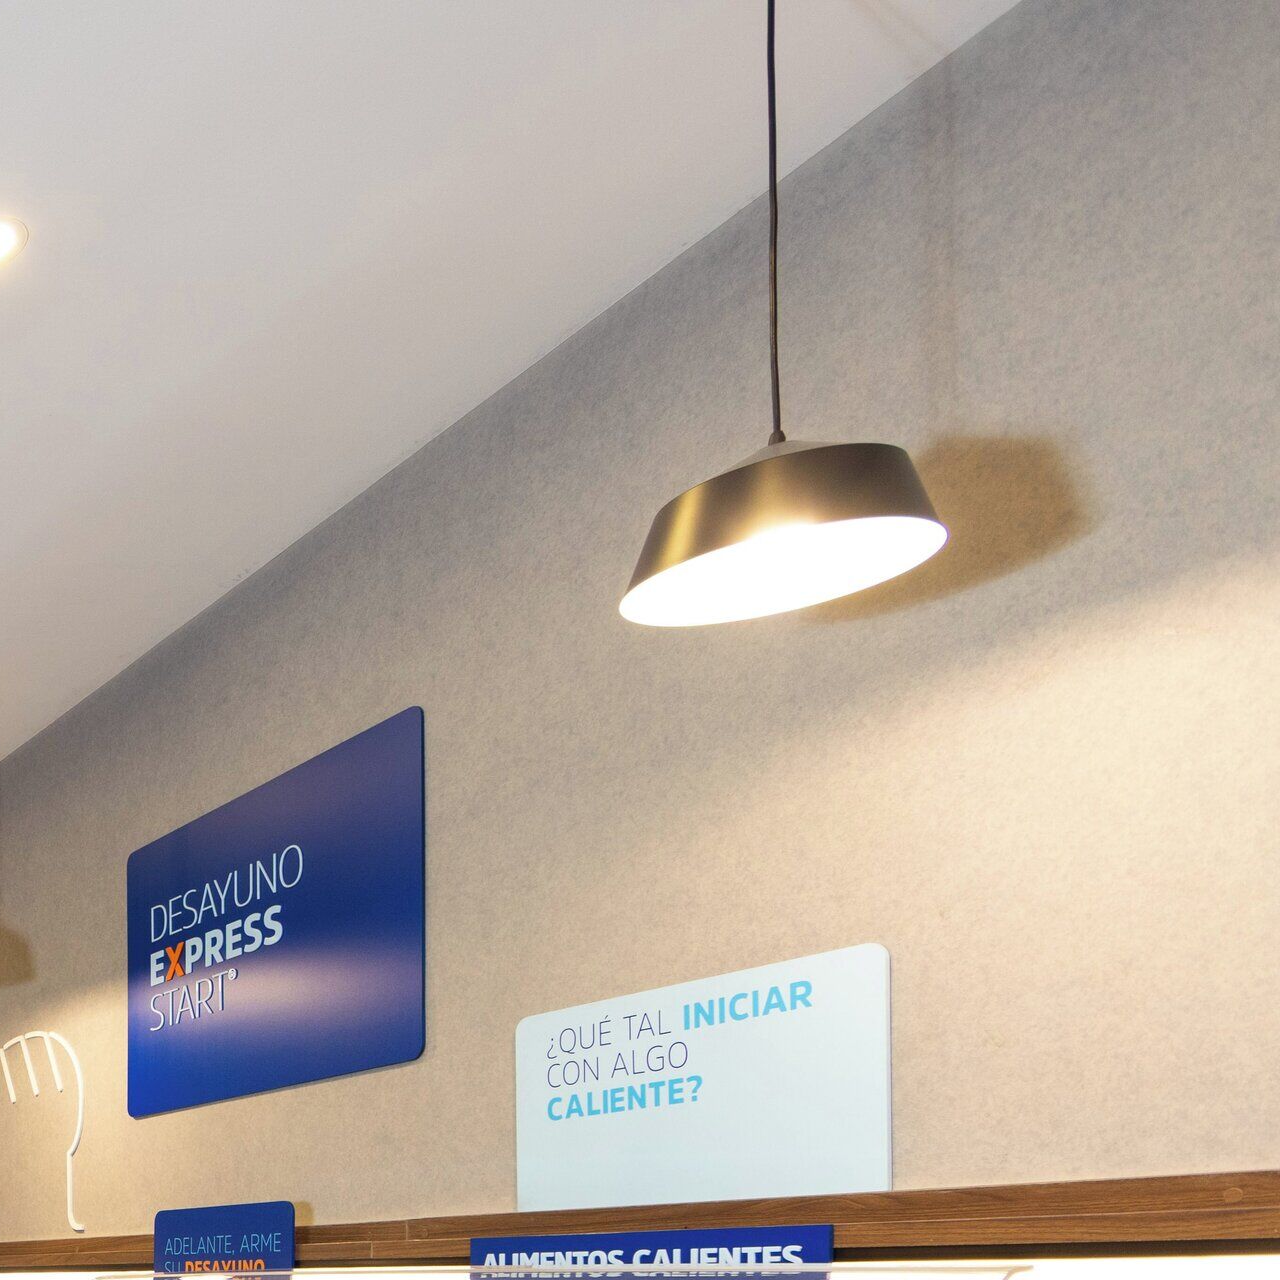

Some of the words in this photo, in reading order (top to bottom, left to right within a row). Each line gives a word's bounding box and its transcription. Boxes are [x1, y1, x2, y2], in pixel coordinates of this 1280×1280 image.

[150, 844, 304, 944] DESAYUNO
[150, 904, 284, 988] EXPRESS
[546, 1014, 612, 1060] ¿QUÉ
[623, 1009, 672, 1041] TAL
[682, 980, 813, 1031] INICIAR
[546, 1056, 600, 1089] CON
[610, 1040, 689, 1079] ALGO
[546, 1074, 704, 1122] CALIENTE?
[164, 1234, 235, 1256] ADELANTE,
[240, 1232, 281, 1253] ARME
[480, 1250, 624, 1279] ALIMENTOS
[631, 1245, 804, 1278] CALIENTES
[184, 1259, 266, 1280] DESAYUNO
